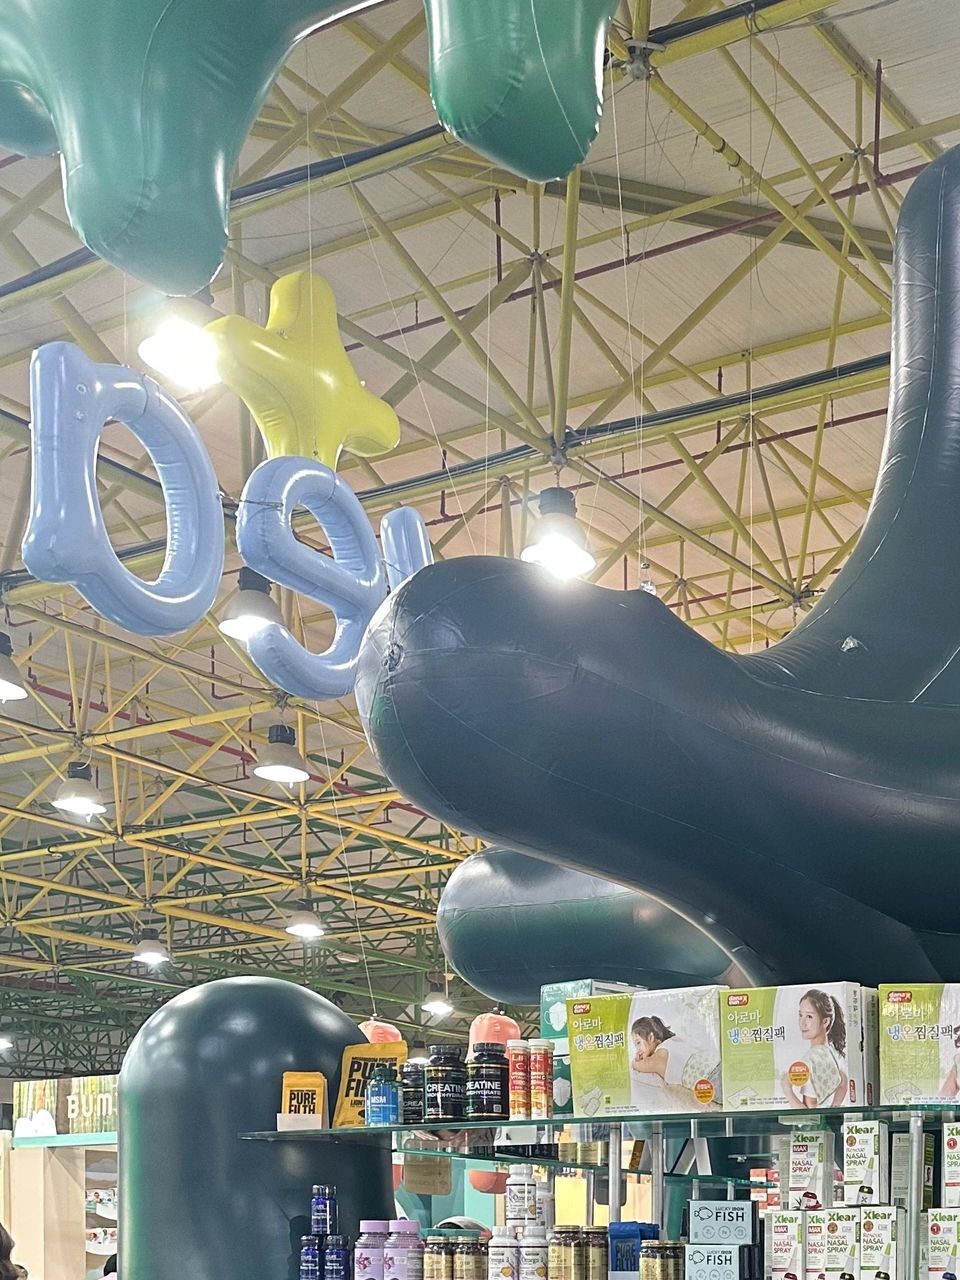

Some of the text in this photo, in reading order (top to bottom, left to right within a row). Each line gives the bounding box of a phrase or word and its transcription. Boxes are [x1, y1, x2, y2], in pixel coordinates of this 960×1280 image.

[727, 1010, 761, 1025] 아로마
[572, 1016, 603, 1031] 아로마
[728, 1026, 786, 1045] 냉온찜질팩
[888, 1024, 954, 1041] 냉온찜질팩
[574, 1032, 625, 1051] 냉온찜질팩
[426, 1083, 466, 1093] CREATIN
[466, 1081, 501, 1091] REATINE
[289, 1092, 317, 1105] PURE
[370, 1096, 387, 1104] MSM
[66, 1092, 118, 1119] BUM
[846, 1125, 875, 1135] Xlear
[793, 1134, 820, 1143] Xlear
[846, 1159, 867, 1167] SPRAY
[715, 1211, 745, 1222] FISH
[774, 1215, 799, 1224] Xlear
[808, 1215, 825, 1224] Xle
[827, 1212, 857, 1222] Xlear
[863, 1210, 893, 1220] Xlear
[930, 1212, 958, 1222] Xlear
[826, 1246, 848, 1254] SPRAY
[706, 1254, 733, 1266] FISH
